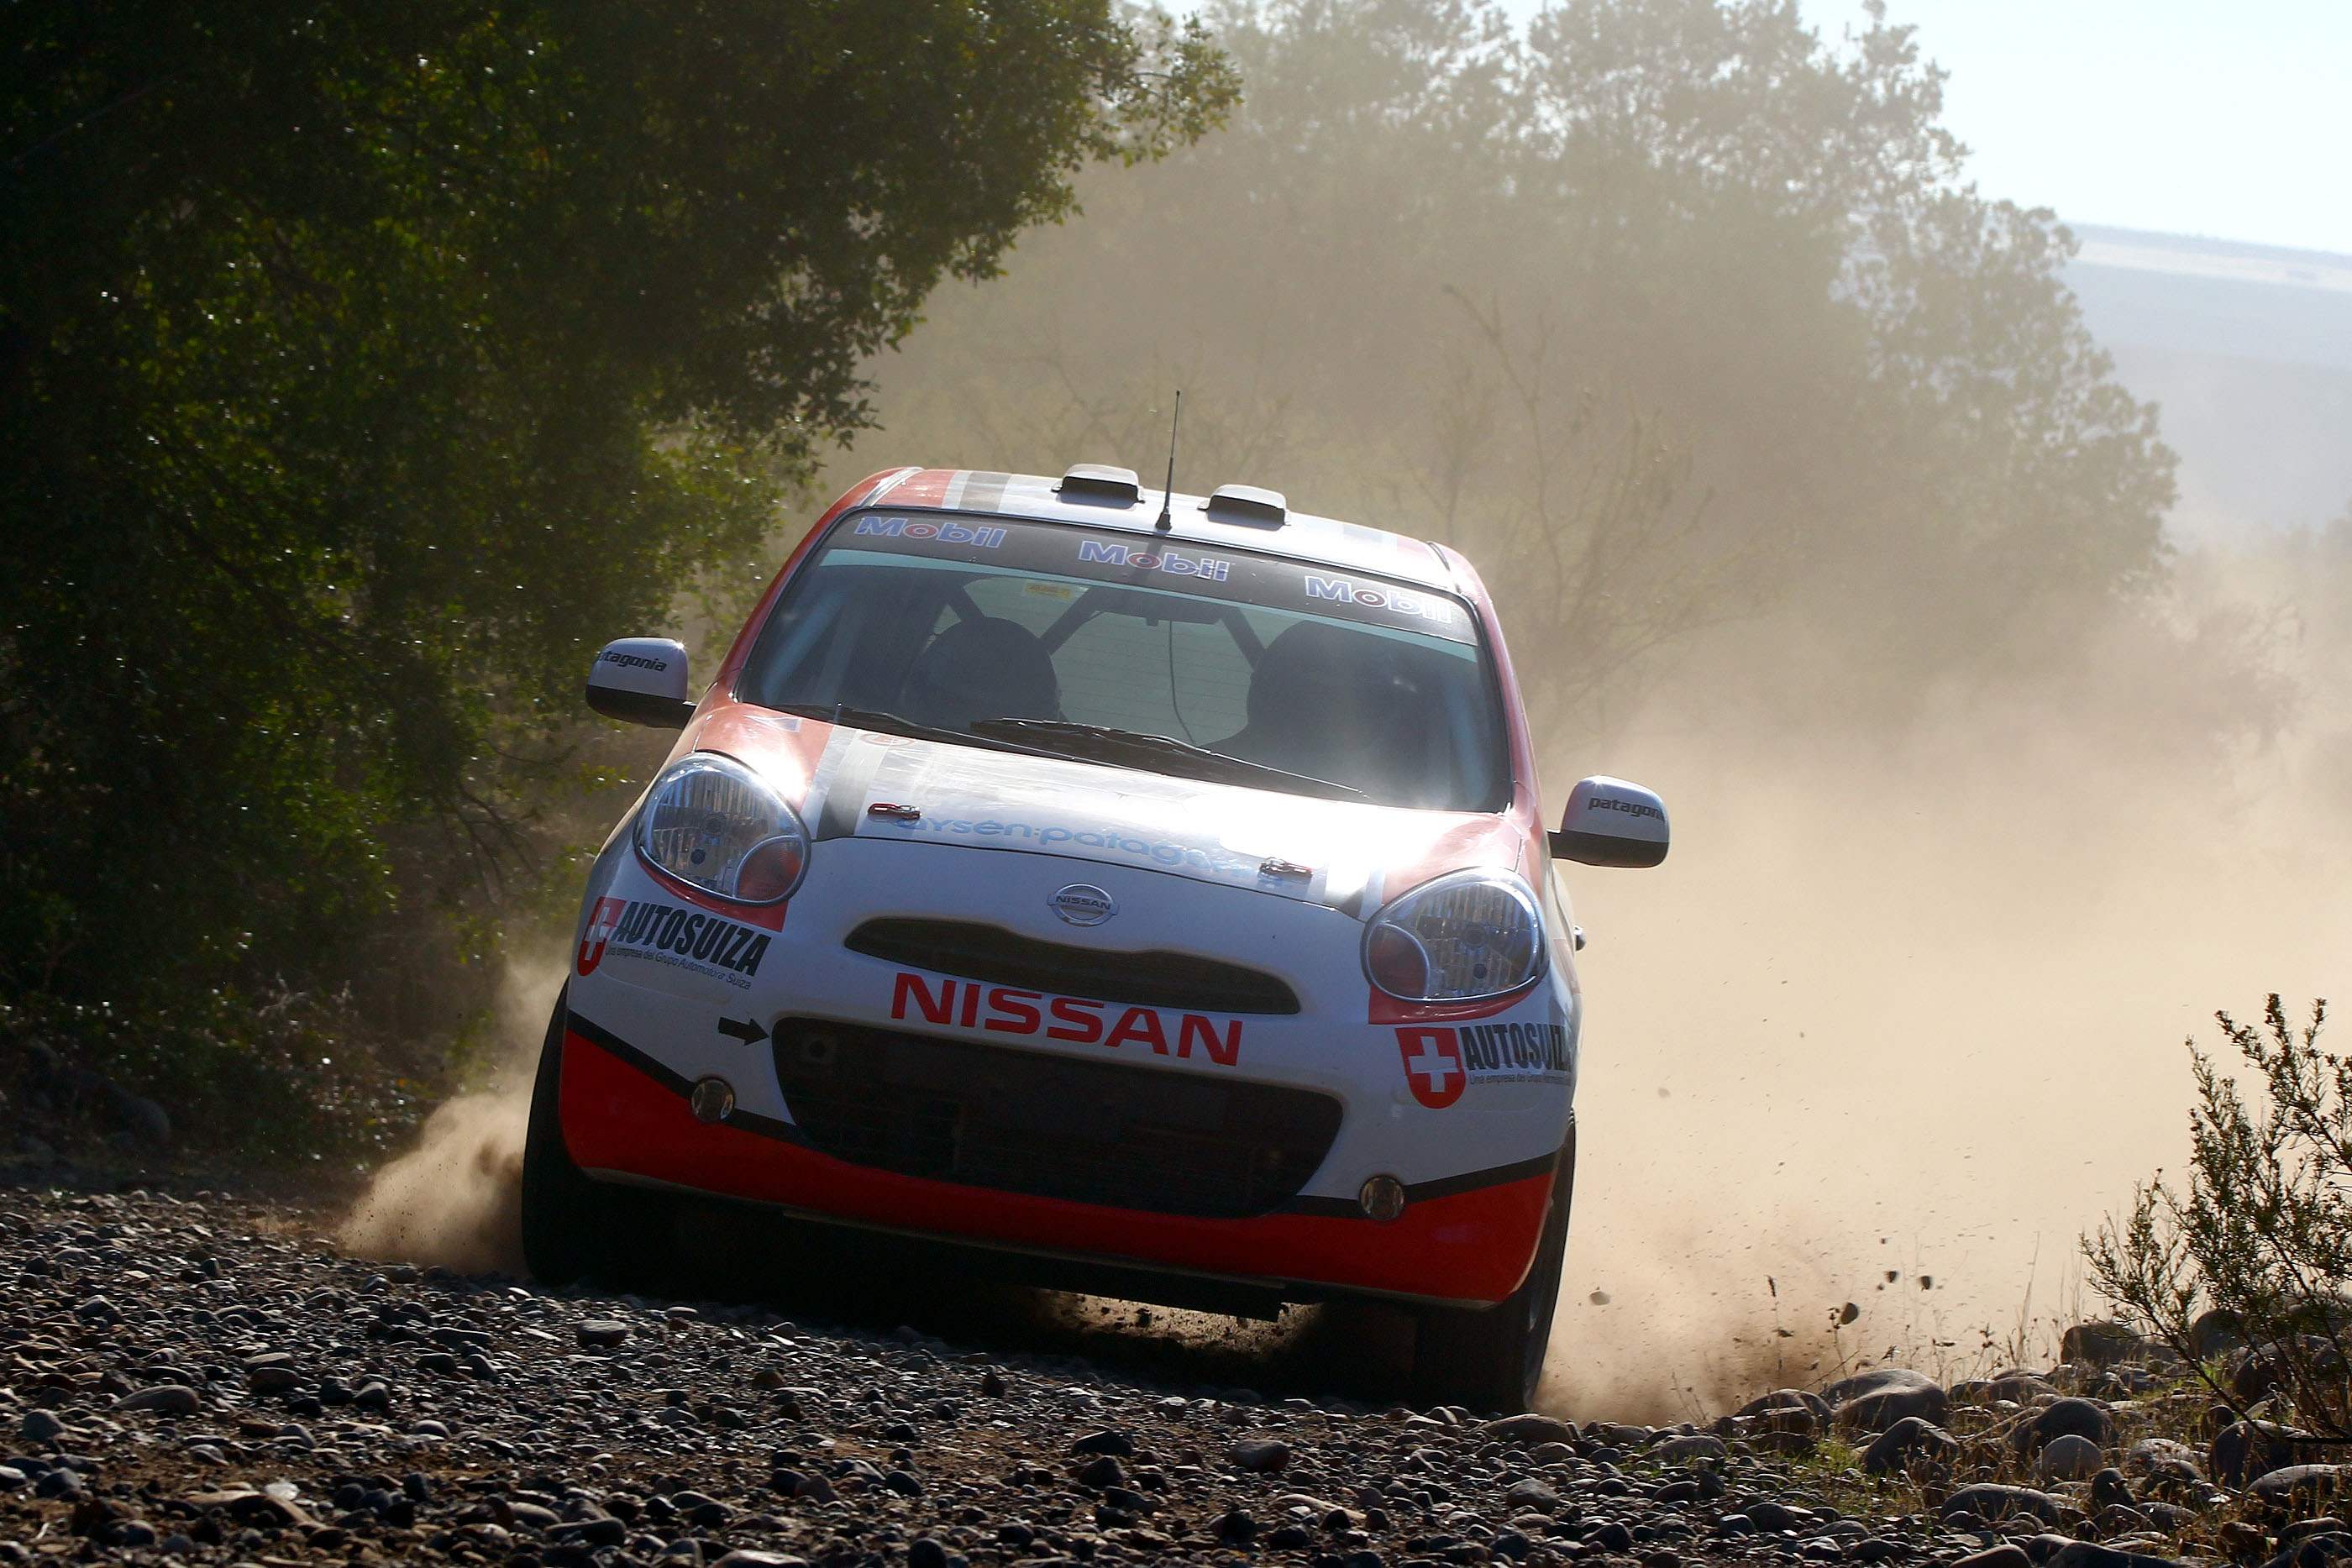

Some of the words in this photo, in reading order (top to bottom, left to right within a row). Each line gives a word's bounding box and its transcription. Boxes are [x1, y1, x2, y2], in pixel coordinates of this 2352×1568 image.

[853, 517, 1007, 548] Mobil
[1078, 540, 1231, 582] Mobil
[1304, 574, 1452, 624] Mobil
[597, 650, 668, 672] tagonia
[1588, 797, 1665, 822] patagon
[1055, 895, 1111, 910] NISSAN
[611, 900, 772, 977] AUTOSUIZA
[655, 952, 677, 968] Grupo
[678, 957, 726, 981] Automotora
[726, 973, 752, 990] Suiza
[890, 972, 1243, 1067] NISSAN
